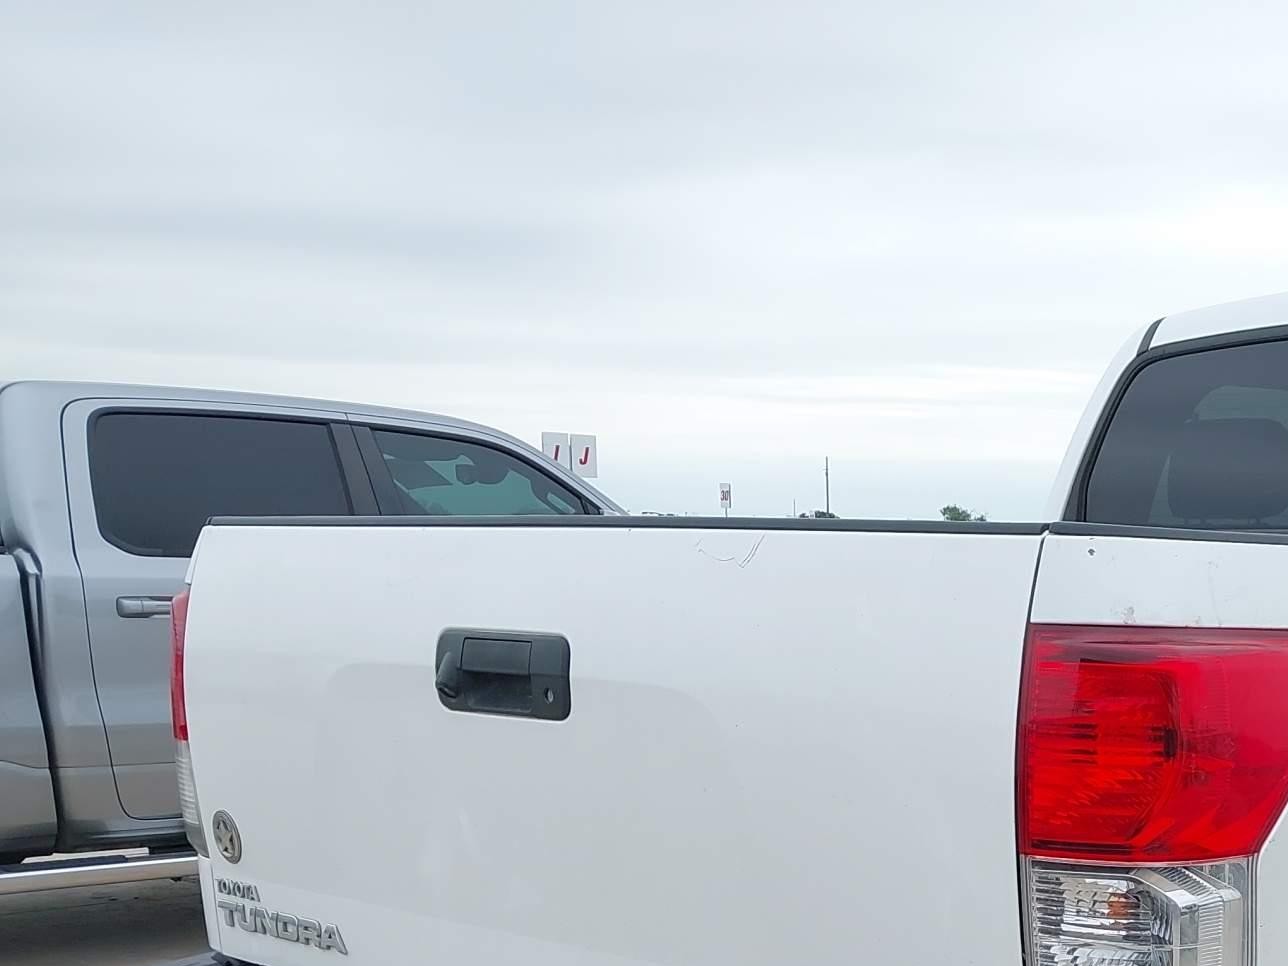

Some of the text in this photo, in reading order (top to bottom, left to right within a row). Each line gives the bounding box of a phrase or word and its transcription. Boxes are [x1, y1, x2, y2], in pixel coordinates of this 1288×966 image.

[553, 444, 560, 461] I
[578, 446, 590, 465] J
[720, 489, 729, 501] 30
[216, 878, 260, 902] TOYOTA
[218, 898, 348, 955] TUNDRA
